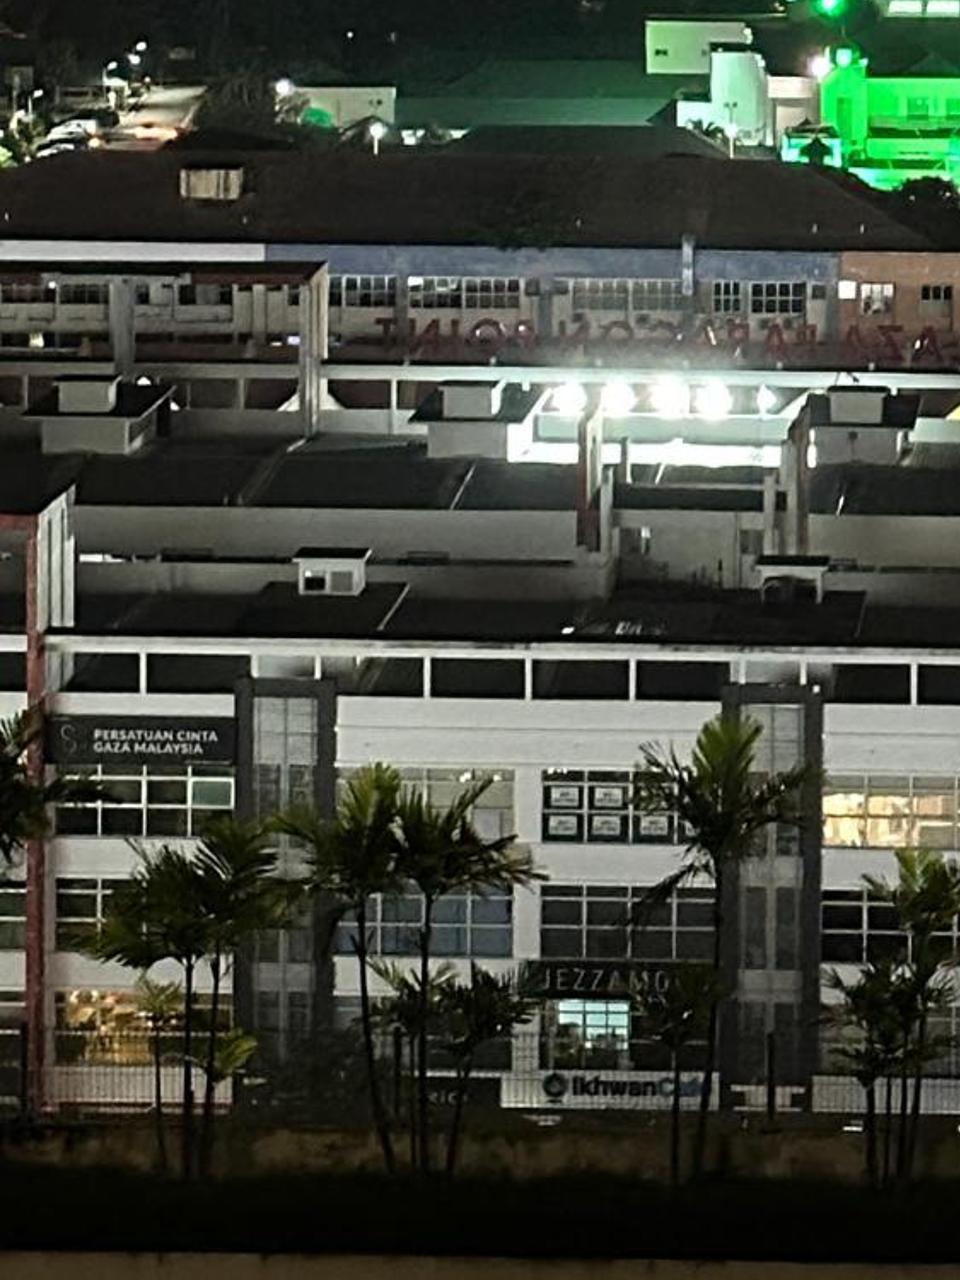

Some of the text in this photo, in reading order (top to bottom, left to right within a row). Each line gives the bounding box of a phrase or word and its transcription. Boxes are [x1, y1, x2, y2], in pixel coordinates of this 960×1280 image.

[93, 728, 218, 742] PERSATUAN CINTA
[93, 741, 203, 754] GAZA MALAYSIA
